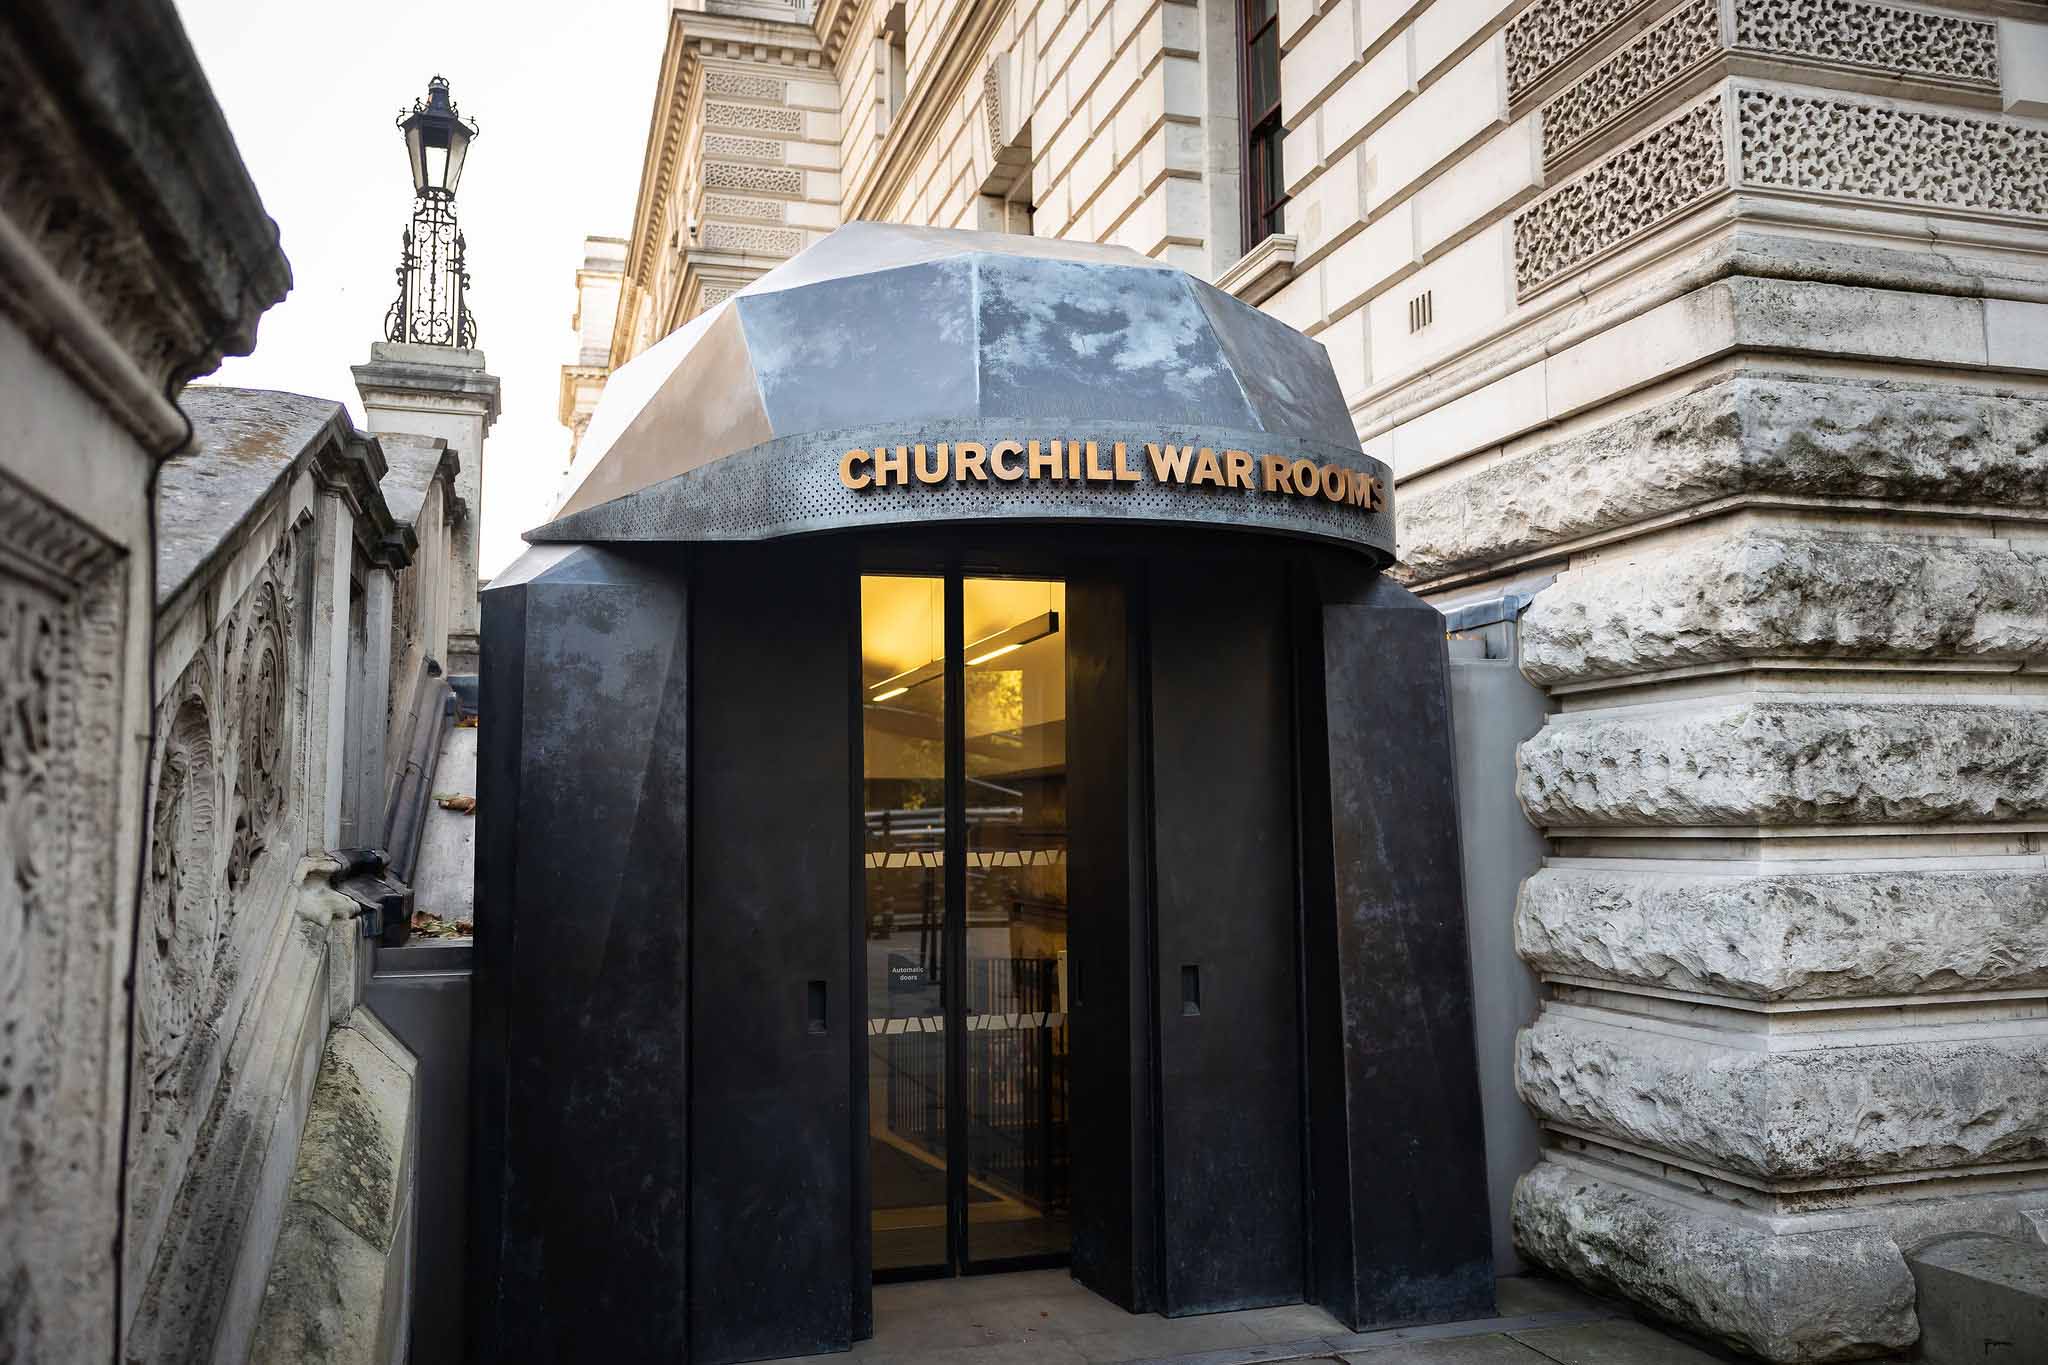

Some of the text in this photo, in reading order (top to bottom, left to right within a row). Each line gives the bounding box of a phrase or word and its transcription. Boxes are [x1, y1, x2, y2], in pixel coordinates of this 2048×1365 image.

[839, 440, 1387, 512] CHURCHILL WAR ROOMS
